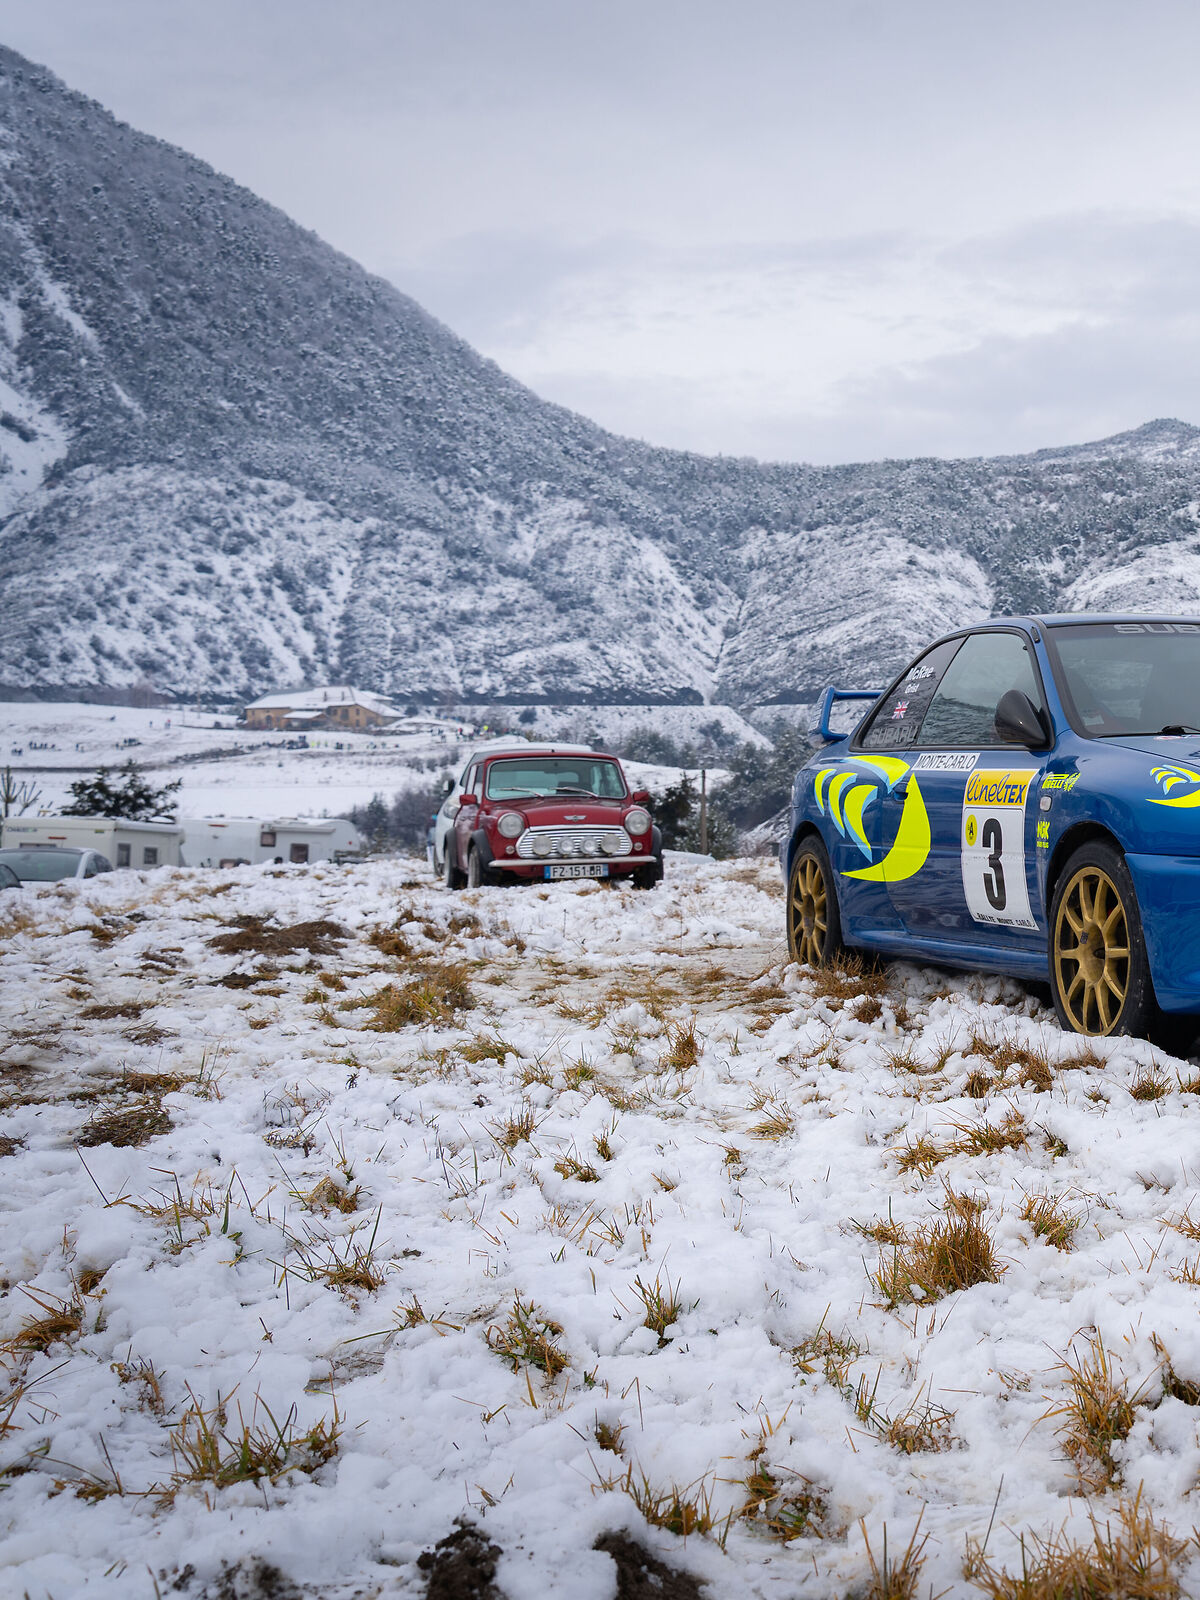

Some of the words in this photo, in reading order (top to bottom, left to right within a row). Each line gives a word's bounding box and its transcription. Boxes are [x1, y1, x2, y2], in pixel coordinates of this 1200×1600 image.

[904, 665, 935, 681] McRae
[918, 754, 977, 770] MONTE-CARLO
[1041, 773, 1070, 789] PIRELLI
[1036, 820, 1051, 840] NGK
[982, 817, 1007, 912] 3
